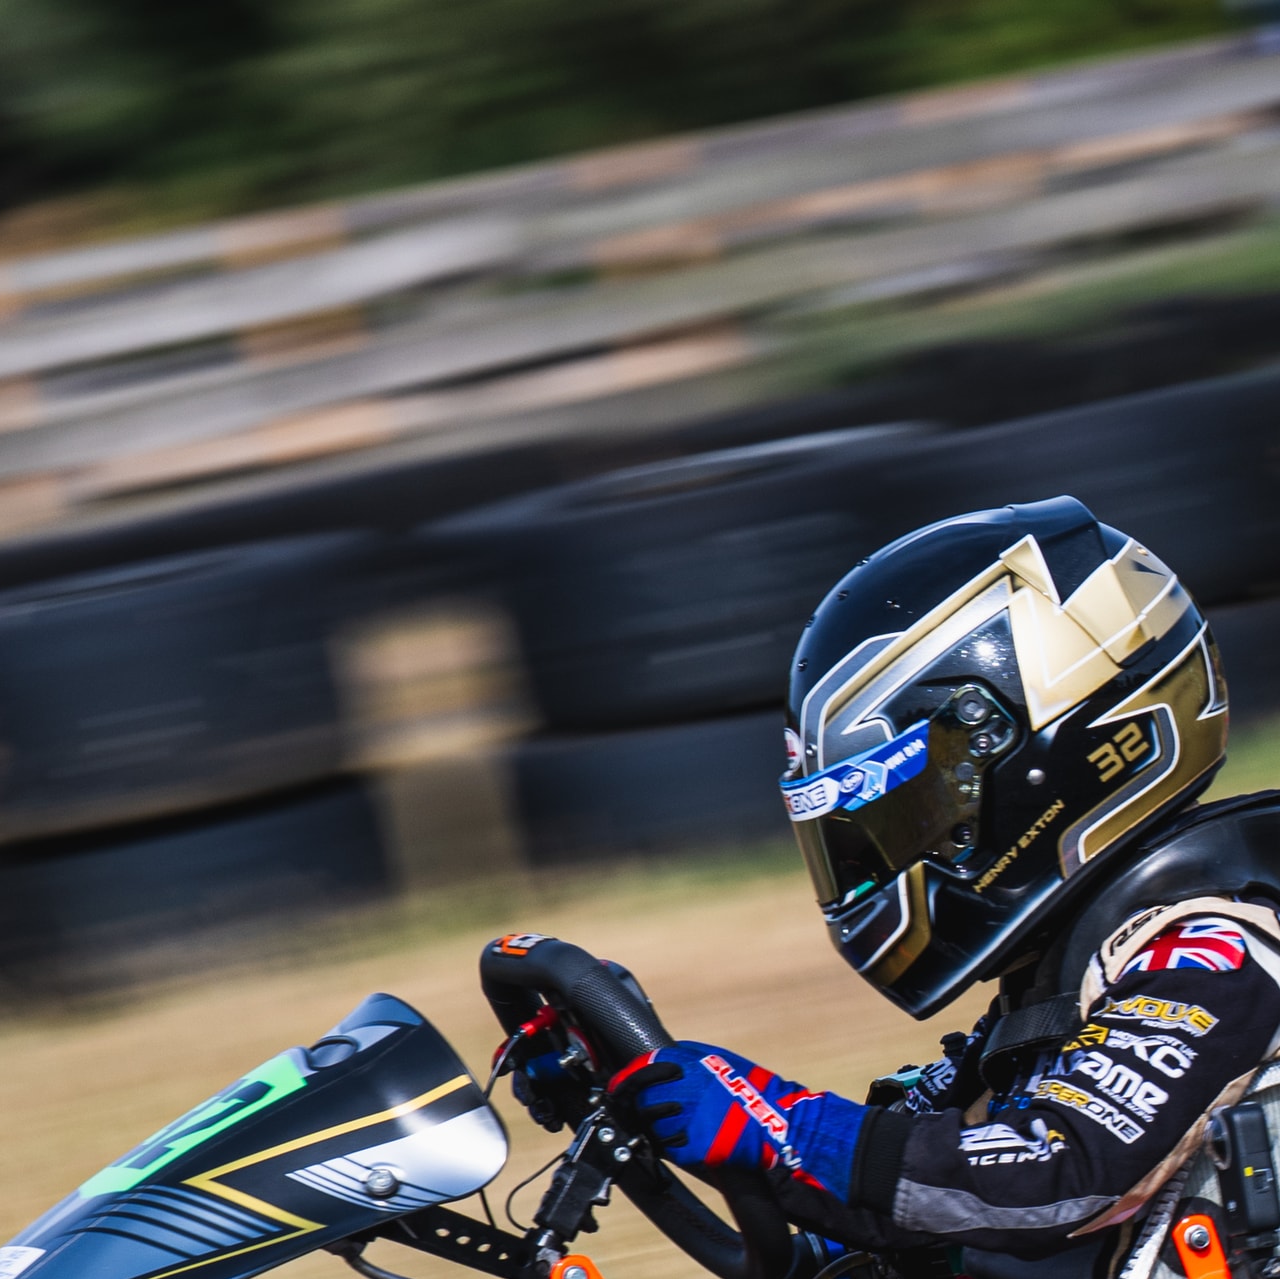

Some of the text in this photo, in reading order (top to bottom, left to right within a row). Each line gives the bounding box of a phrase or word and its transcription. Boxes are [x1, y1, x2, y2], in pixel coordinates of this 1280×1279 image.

[1086, 722, 1150, 783] 32
[973, 800, 1065, 893] HENRY EXTON
